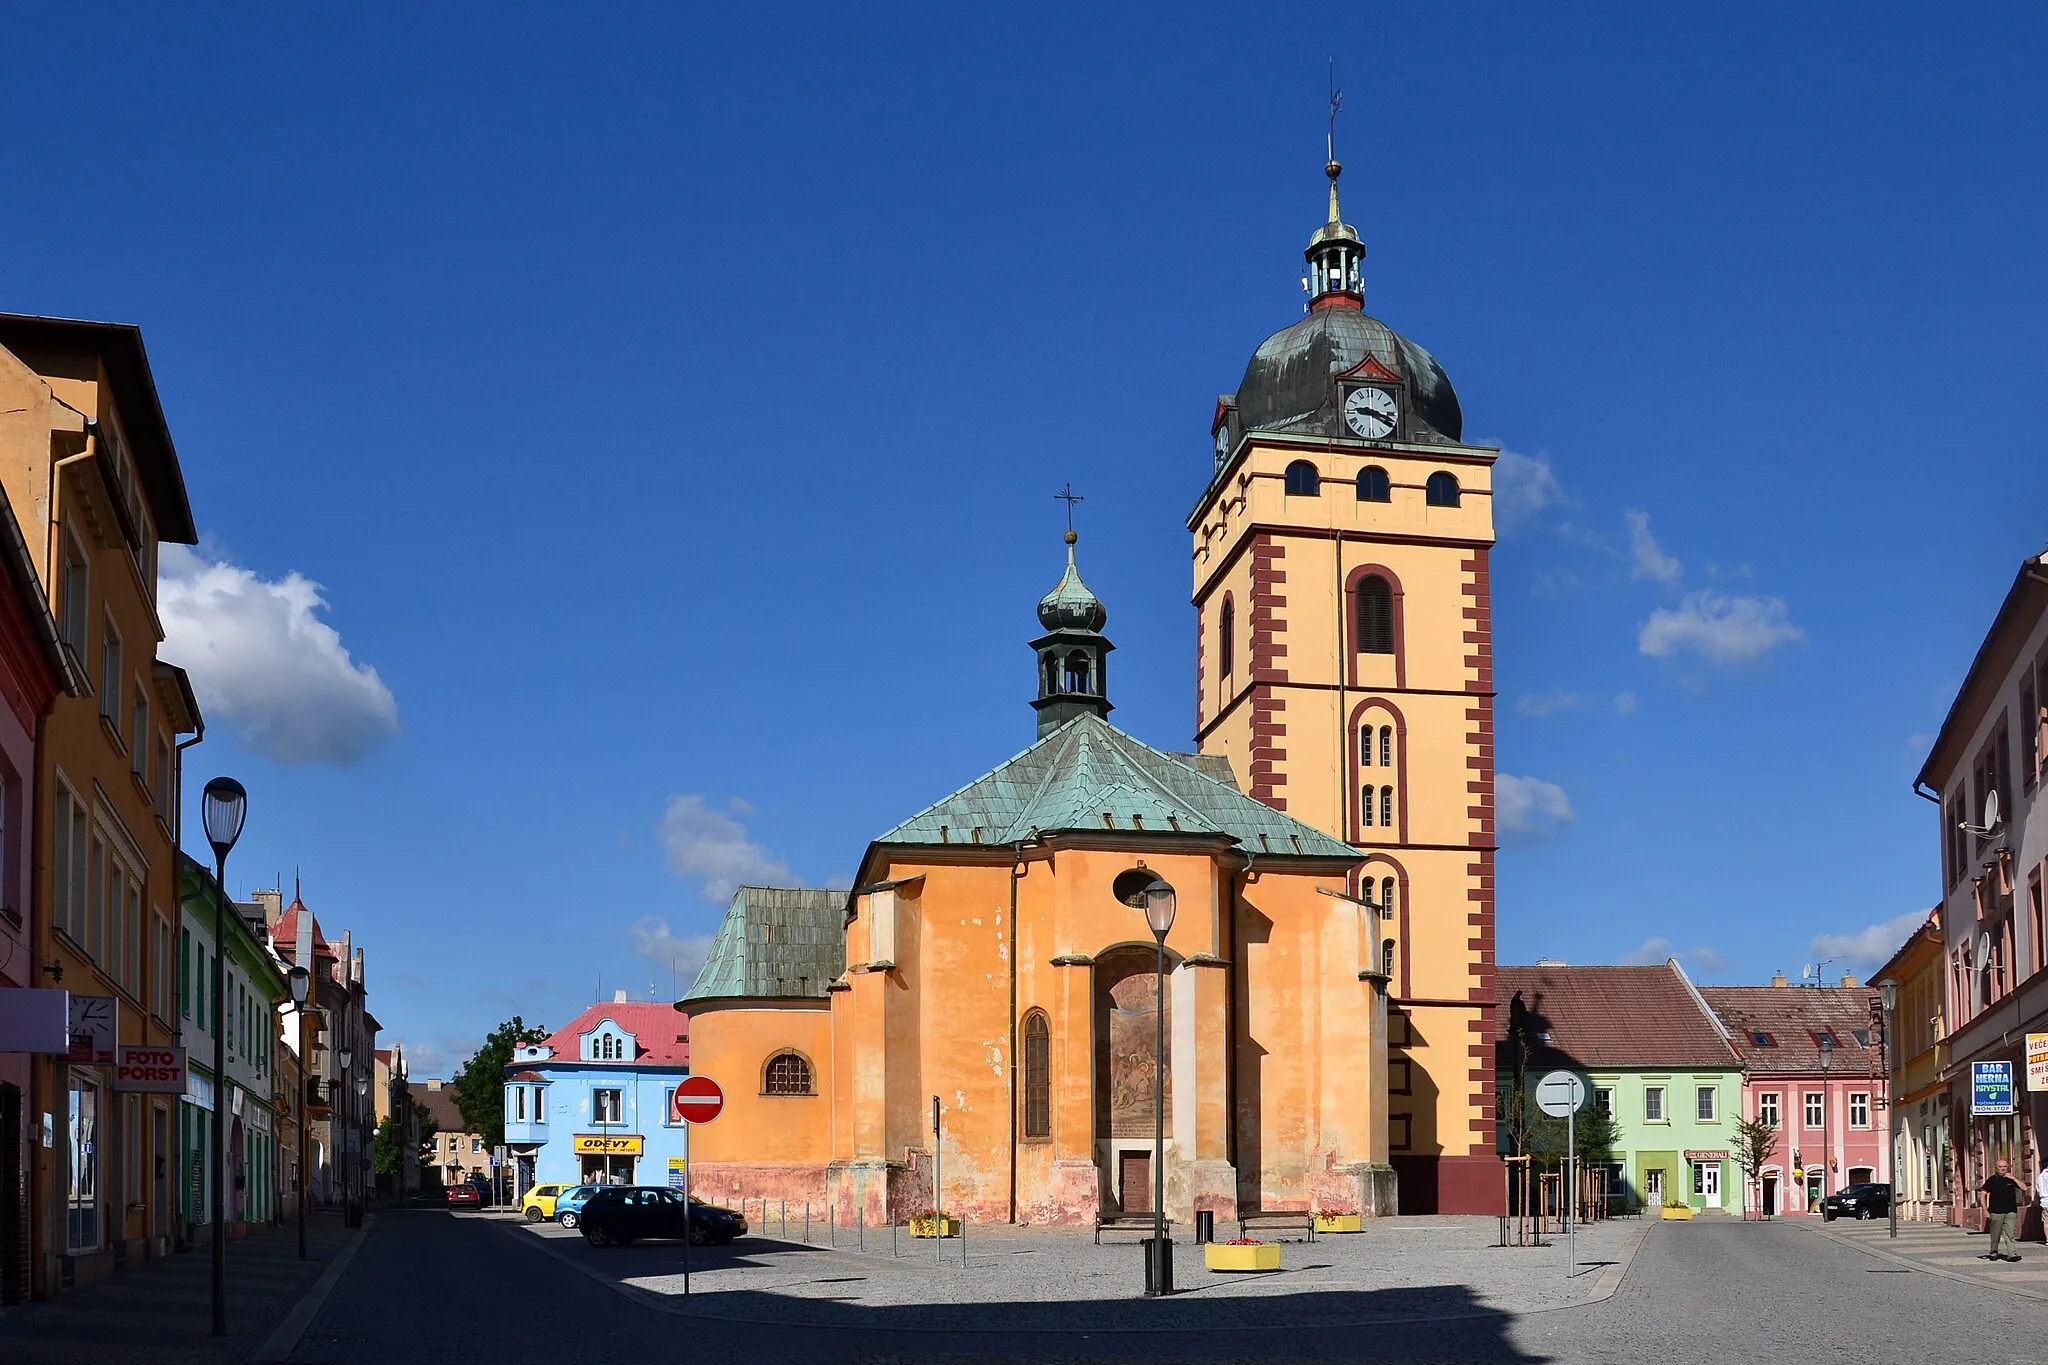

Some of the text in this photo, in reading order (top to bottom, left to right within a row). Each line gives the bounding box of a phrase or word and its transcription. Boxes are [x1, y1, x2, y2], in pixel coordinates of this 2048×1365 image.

[125, 1051, 174, 1065] FOTO
[1982, 1064, 2003, 1073] BAR
[118, 1067, 180, 1081] PORST
[1975, 1073, 2009, 1083] HERNA
[1975, 1084, 2009, 1092] KRYSTAL
[583, 1138, 629, 1148] ODĚVY
